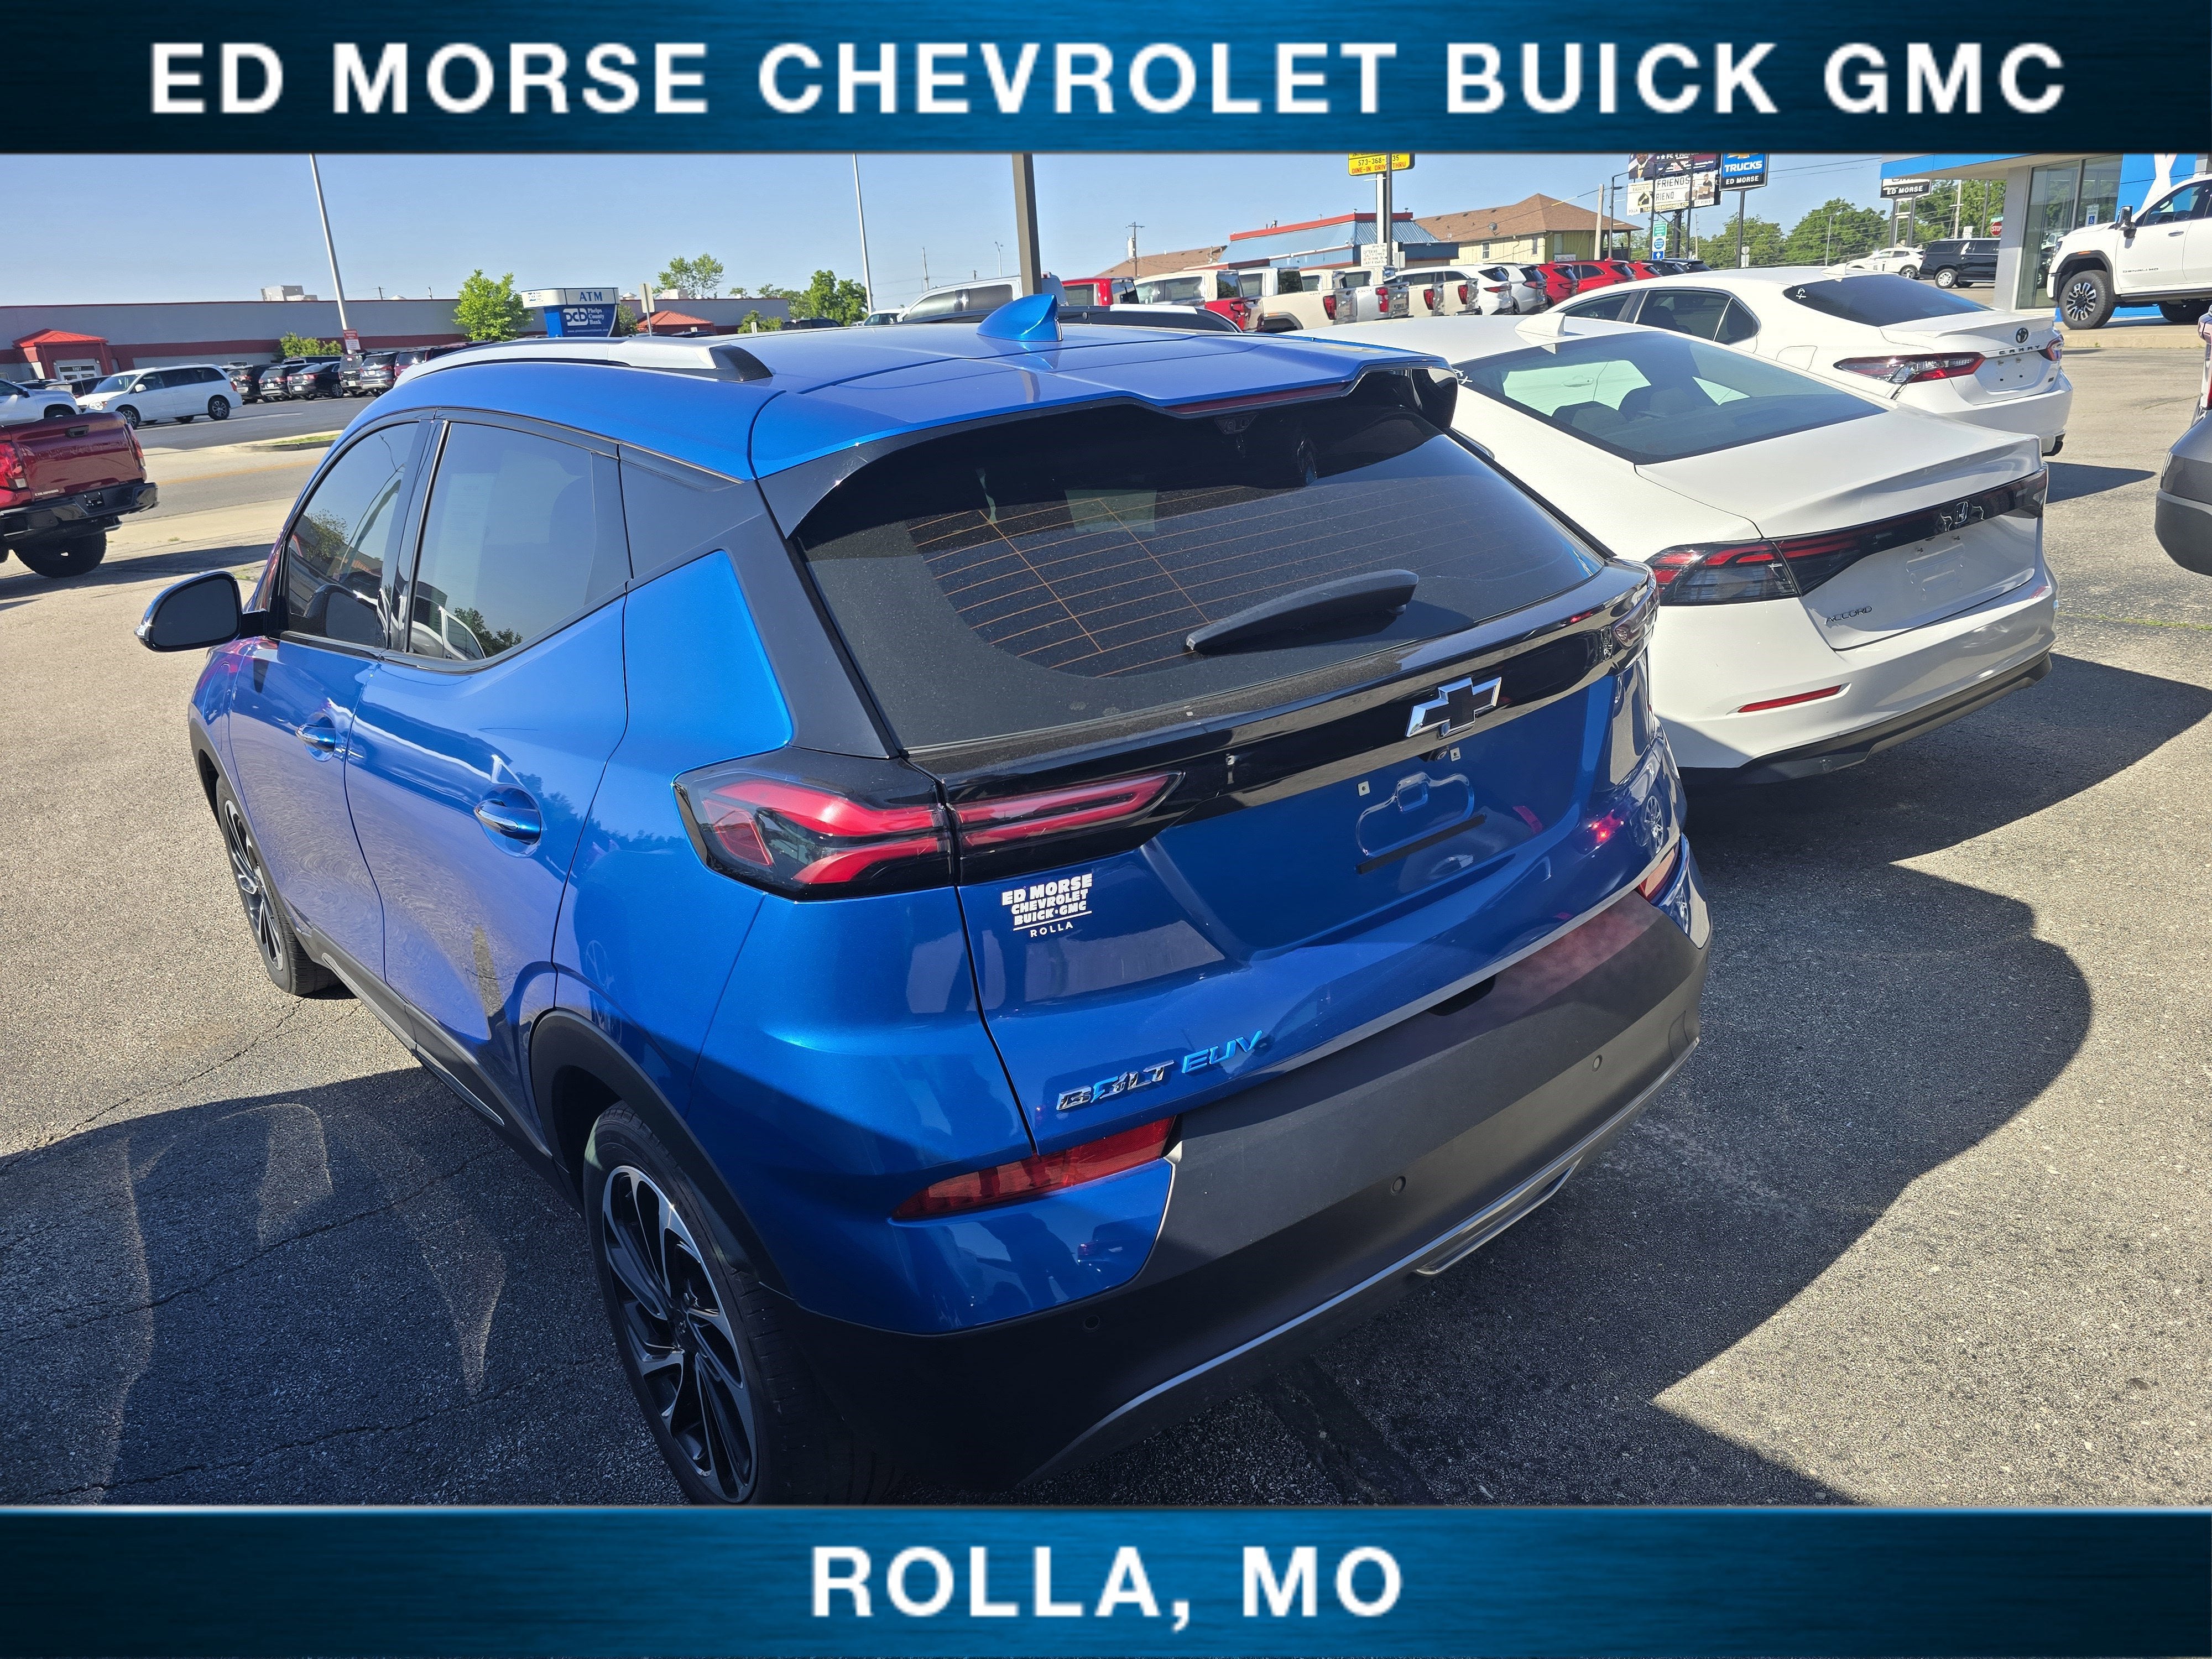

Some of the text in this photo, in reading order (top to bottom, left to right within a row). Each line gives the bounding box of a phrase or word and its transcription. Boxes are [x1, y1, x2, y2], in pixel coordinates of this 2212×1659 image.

[1724, 160, 1762, 173] TRUCKS
[1657, 176, 1691, 188] FRIENDS
[1898, 185, 1923, 194] MORSE
[580, 291, 603, 302] ATM
[1999, 345, 2041, 355] CAMRY
[1825, 606, 1872, 625] ACCORD
[1002, 873, 1093, 906] ED MORSE
[1011, 888, 1088, 915] CHEVROLET
[1030, 921, 1073, 937] ROLLA
[1056, 1030, 1263, 1111] BOLT EUV
